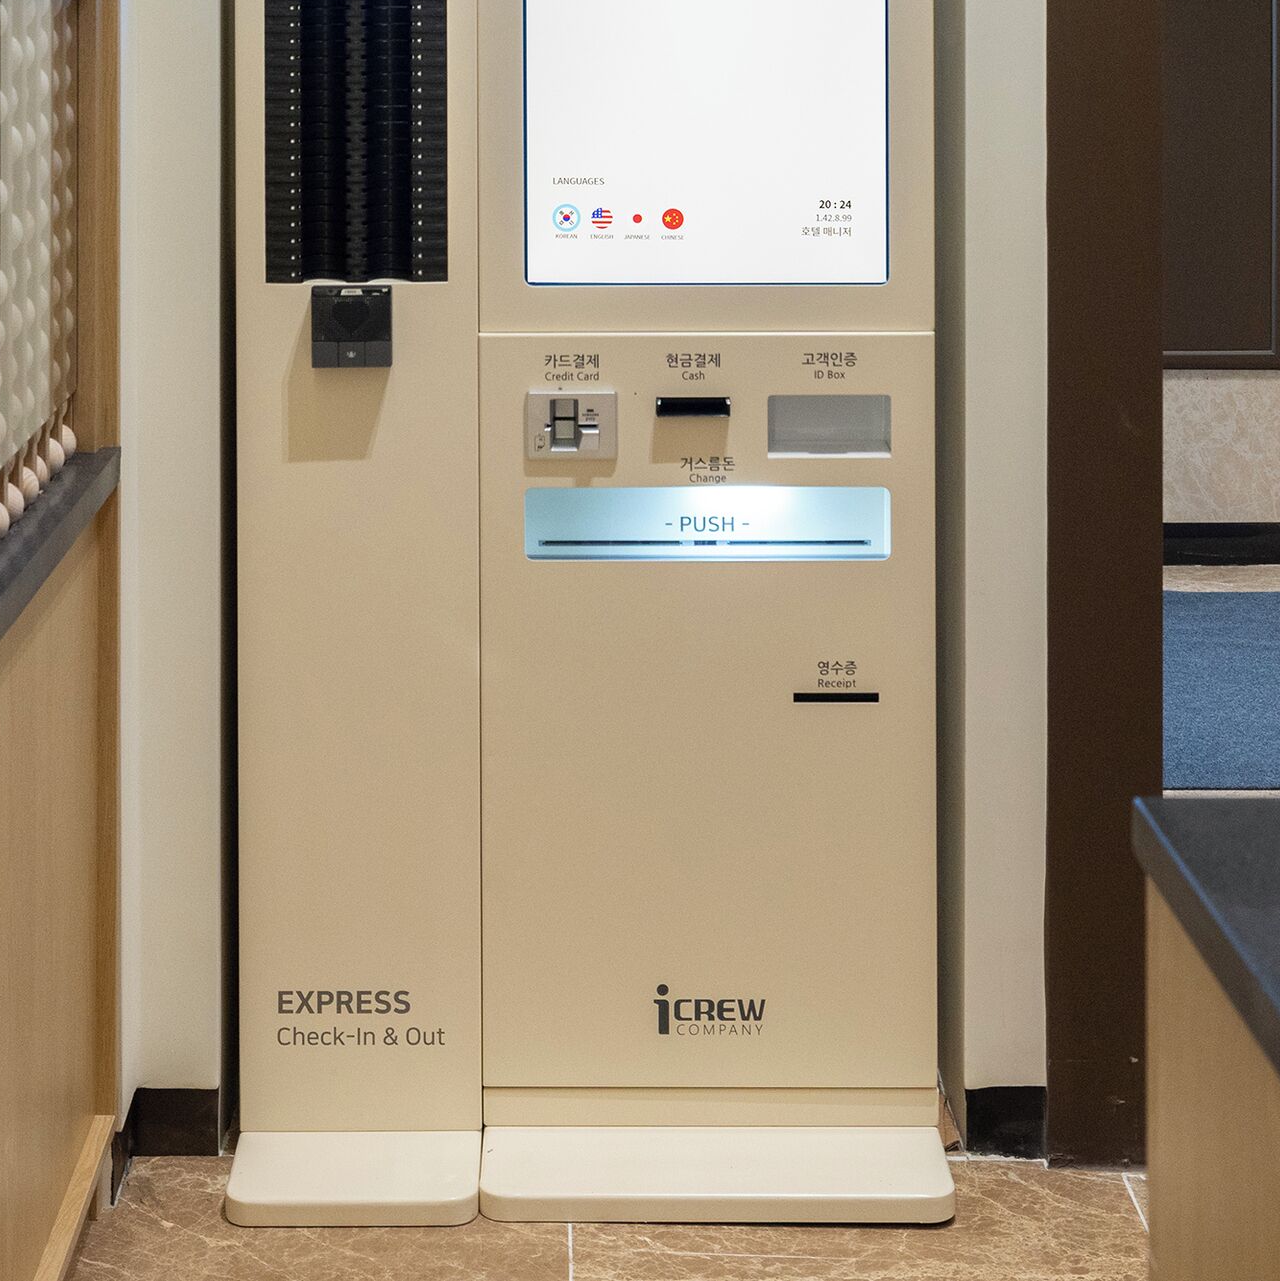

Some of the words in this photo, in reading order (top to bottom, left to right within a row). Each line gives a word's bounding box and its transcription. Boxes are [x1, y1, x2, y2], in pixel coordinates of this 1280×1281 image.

[552, 177, 605, 186] LANGUAGES
[544, 353, 600, 369] 카드결제
[666, 353, 721, 368] 현금결제
[801, 352, 858, 367] 고객인증
[544, 371, 573, 382] Credit
[576, 371, 600, 382] Card
[681, 370, 705, 381] Cash
[814, 370, 825, 380] ID
[827, 370, 846, 380] Box
[680, 456, 736, 472] 거스름돈
[689, 473, 727, 484] Change
[680, 516, 735, 532] PUSH
[817, 660, 857, 676] 영수증
[817, 678, 857, 689] Receipt
[277, 990, 411, 1015] EXPRESS
[277, 1026, 376, 1046] Check-In
[383, 1027, 399, 1046] &
[406, 1026, 446, 1046] Out
[676, 1023, 764, 1036] COMPANY
